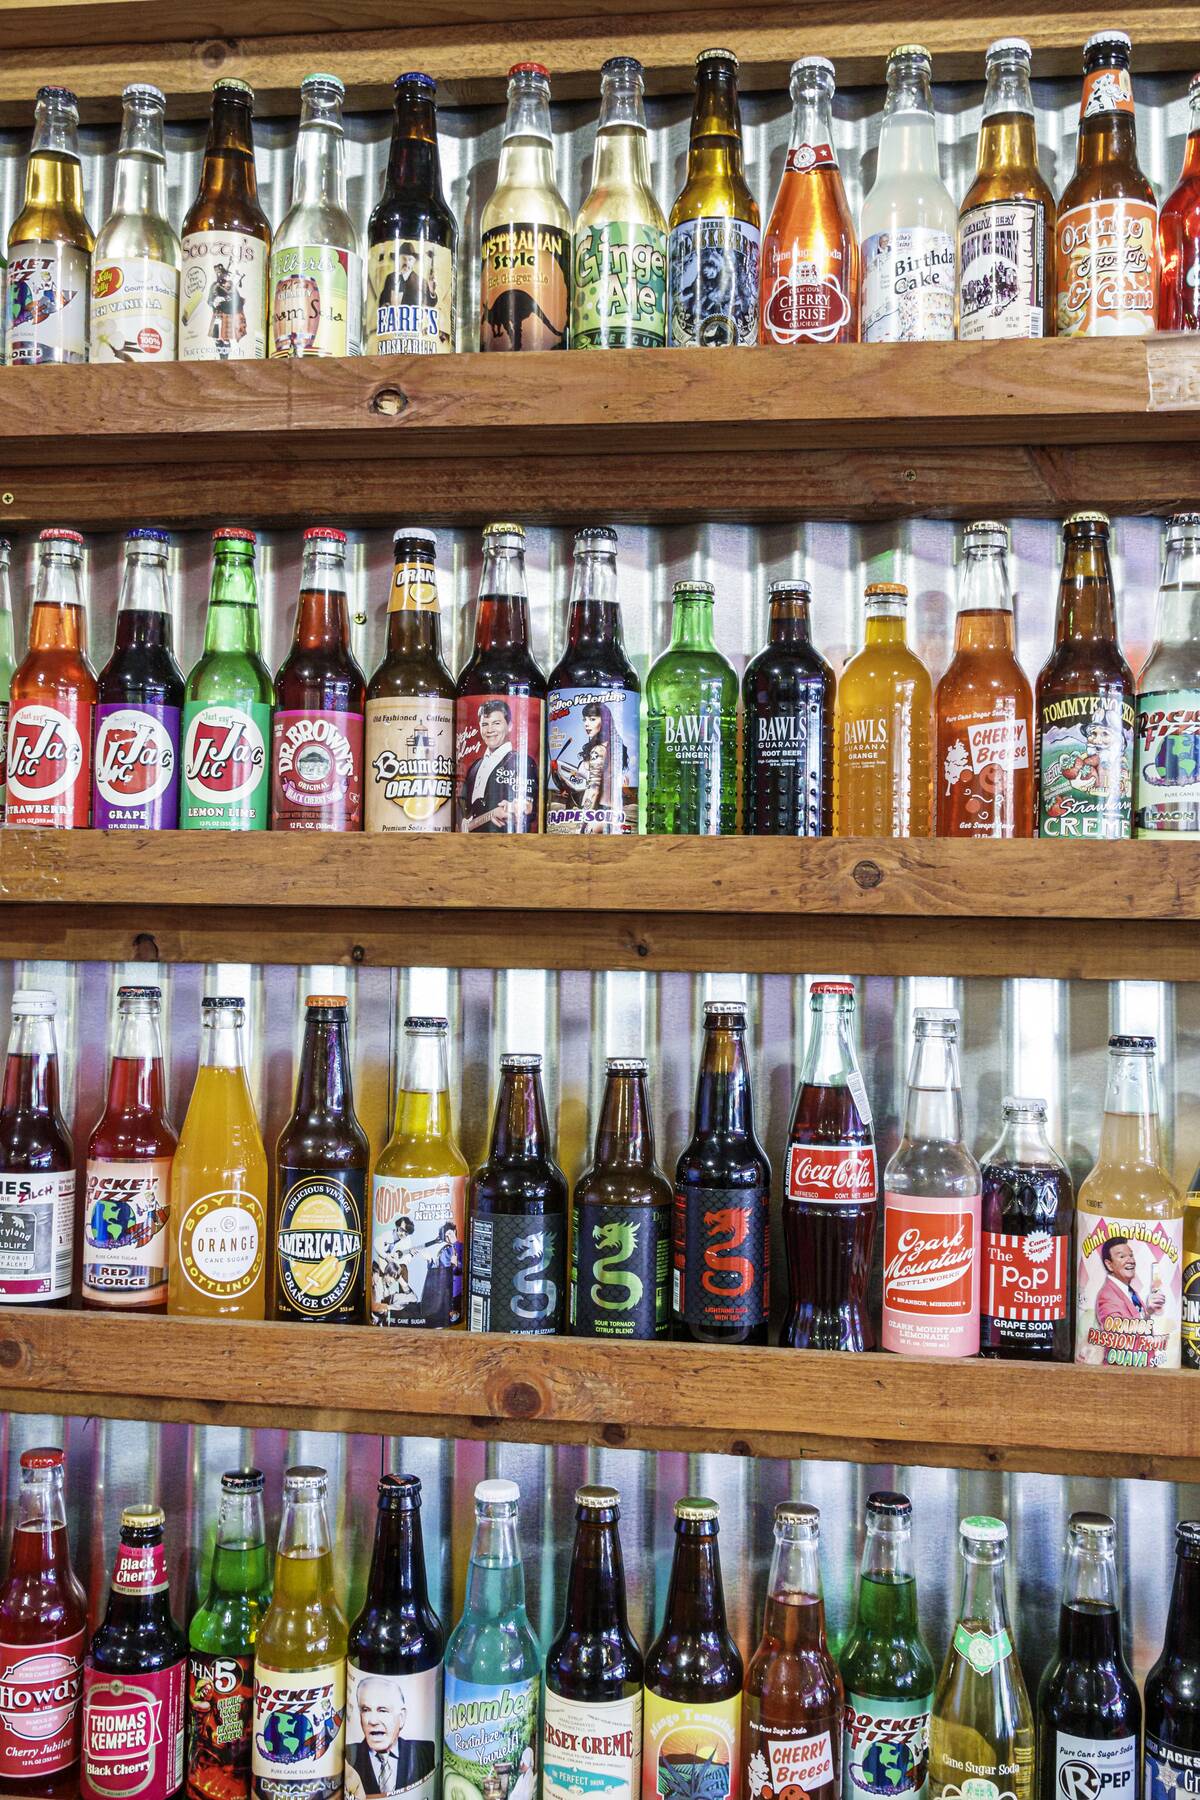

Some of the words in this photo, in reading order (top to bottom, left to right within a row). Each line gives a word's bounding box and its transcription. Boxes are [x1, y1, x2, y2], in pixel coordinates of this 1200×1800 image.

[494, 252, 535, 270] Style
[894, 271, 940, 295] Cake
[598, 275, 657, 322] Ale
[780, 294, 830, 308] CHERRY
[377, 307, 439, 336] EARP'S
[783, 309, 826, 322] CERISE
[574, 691, 626, 705] Valentine
[383, 715, 417, 723] Fashioned
[665, 715, 721, 743] BAWLS
[759, 716, 807, 741] BAWLS
[844, 719, 886, 745] BAWLS
[496, 767, 516, 777] Soy
[298, 781, 329, 790] ORIGINAL
[385, 779, 453, 798] ORANGE
[286, 787, 304, 802] BLACK
[109, 811, 148, 820] GRAPE
[188, 808, 224, 817] LEMON
[1145, 811, 1194, 823] LEMON
[288, 1185, 325, 1212] DELICIOUS
[325, 1185, 352, 1214] VINTAGE
[419, 1202, 450, 1212] Banana
[184, 1194, 264, 1232] BOYLAN
[415, 1211, 432, 1221] Nut
[197, 1235, 255, 1252] ORANGE
[278, 1231, 362, 1260] AMERICANA
[898, 1225, 965, 1259] Ozark
[1028, 1244, 1050, 1255] Sugar
[1029, 1239, 1047, 1247] Cane
[1082, 1230, 1106, 1258] Wink
[227, 1256, 249, 1264] SUGAR
[988, 1247, 1013, 1262] The
[885, 1248, 975, 1278] Mountain
[101, 1267, 129, 1276] RED
[184, 1257, 252, 1293] BOTTLING
[896, 1272, 960, 1286] BOTTLEWORKS
[89, 1275, 146, 1286] LICORICE
[284, 1271, 319, 1309] ORANGE
[320, 1271, 351, 1308] CREAM
[1014, 1291, 1062, 1306] Shoppe
[889, 1320, 914, 1331] OZARK
[994, 1319, 1027, 1330] GRAPE
[1028, 1322, 1053, 1330] SODA
[1104, 1316, 1153, 1335] ORANGE
[899, 1331, 949, 1340] LEMONADE
[1088, 1328, 1135, 1350] PASSION
[1137, 1335, 1169, 1351] FRUIT
[1107, 1349, 1148, 1367] GUAVA
[120, 1557, 154, 1571] Black
[116, 1569, 158, 1583] Cherry
[214, 1661, 237, 1693] 5
[90, 1711, 147, 1733] THOMAS
[773, 1727, 791, 1736] Sugar
[850, 1726, 918, 1750] FIZZ
[5, 1746, 39, 1758] Cherry
[41, 1738, 72, 1754] Jubilee
[91, 1729, 147, 1751] KEMPER
[455, 1729, 500, 1751] Revitalize
[581, 1730, 633, 1758] CREME
[773, 1738, 826, 1764] CHERRY
[1060, 1747, 1076, 1758] Pure
[1077, 1750, 1095, 1758] Cane
[1097, 1750, 1118, 1759] Sugar
[1120, 1745, 1133, 1755] Soda
[87, 1762, 111, 1776] Black
[113, 1760, 150, 1775] Cherry
[776, 1758, 830, 1783] Breese
[942, 1753, 963, 1770] Cane
[965, 1761, 996, 1776] Sugar
[999, 1764, 1020, 1775] Soda
[261, 1778, 325, 1793] BANANA
[559, 1772, 588, 1785] PERFECT
[1102, 1770, 1130, 1788] PEP
[386, 1788, 405, 1797] PURE
